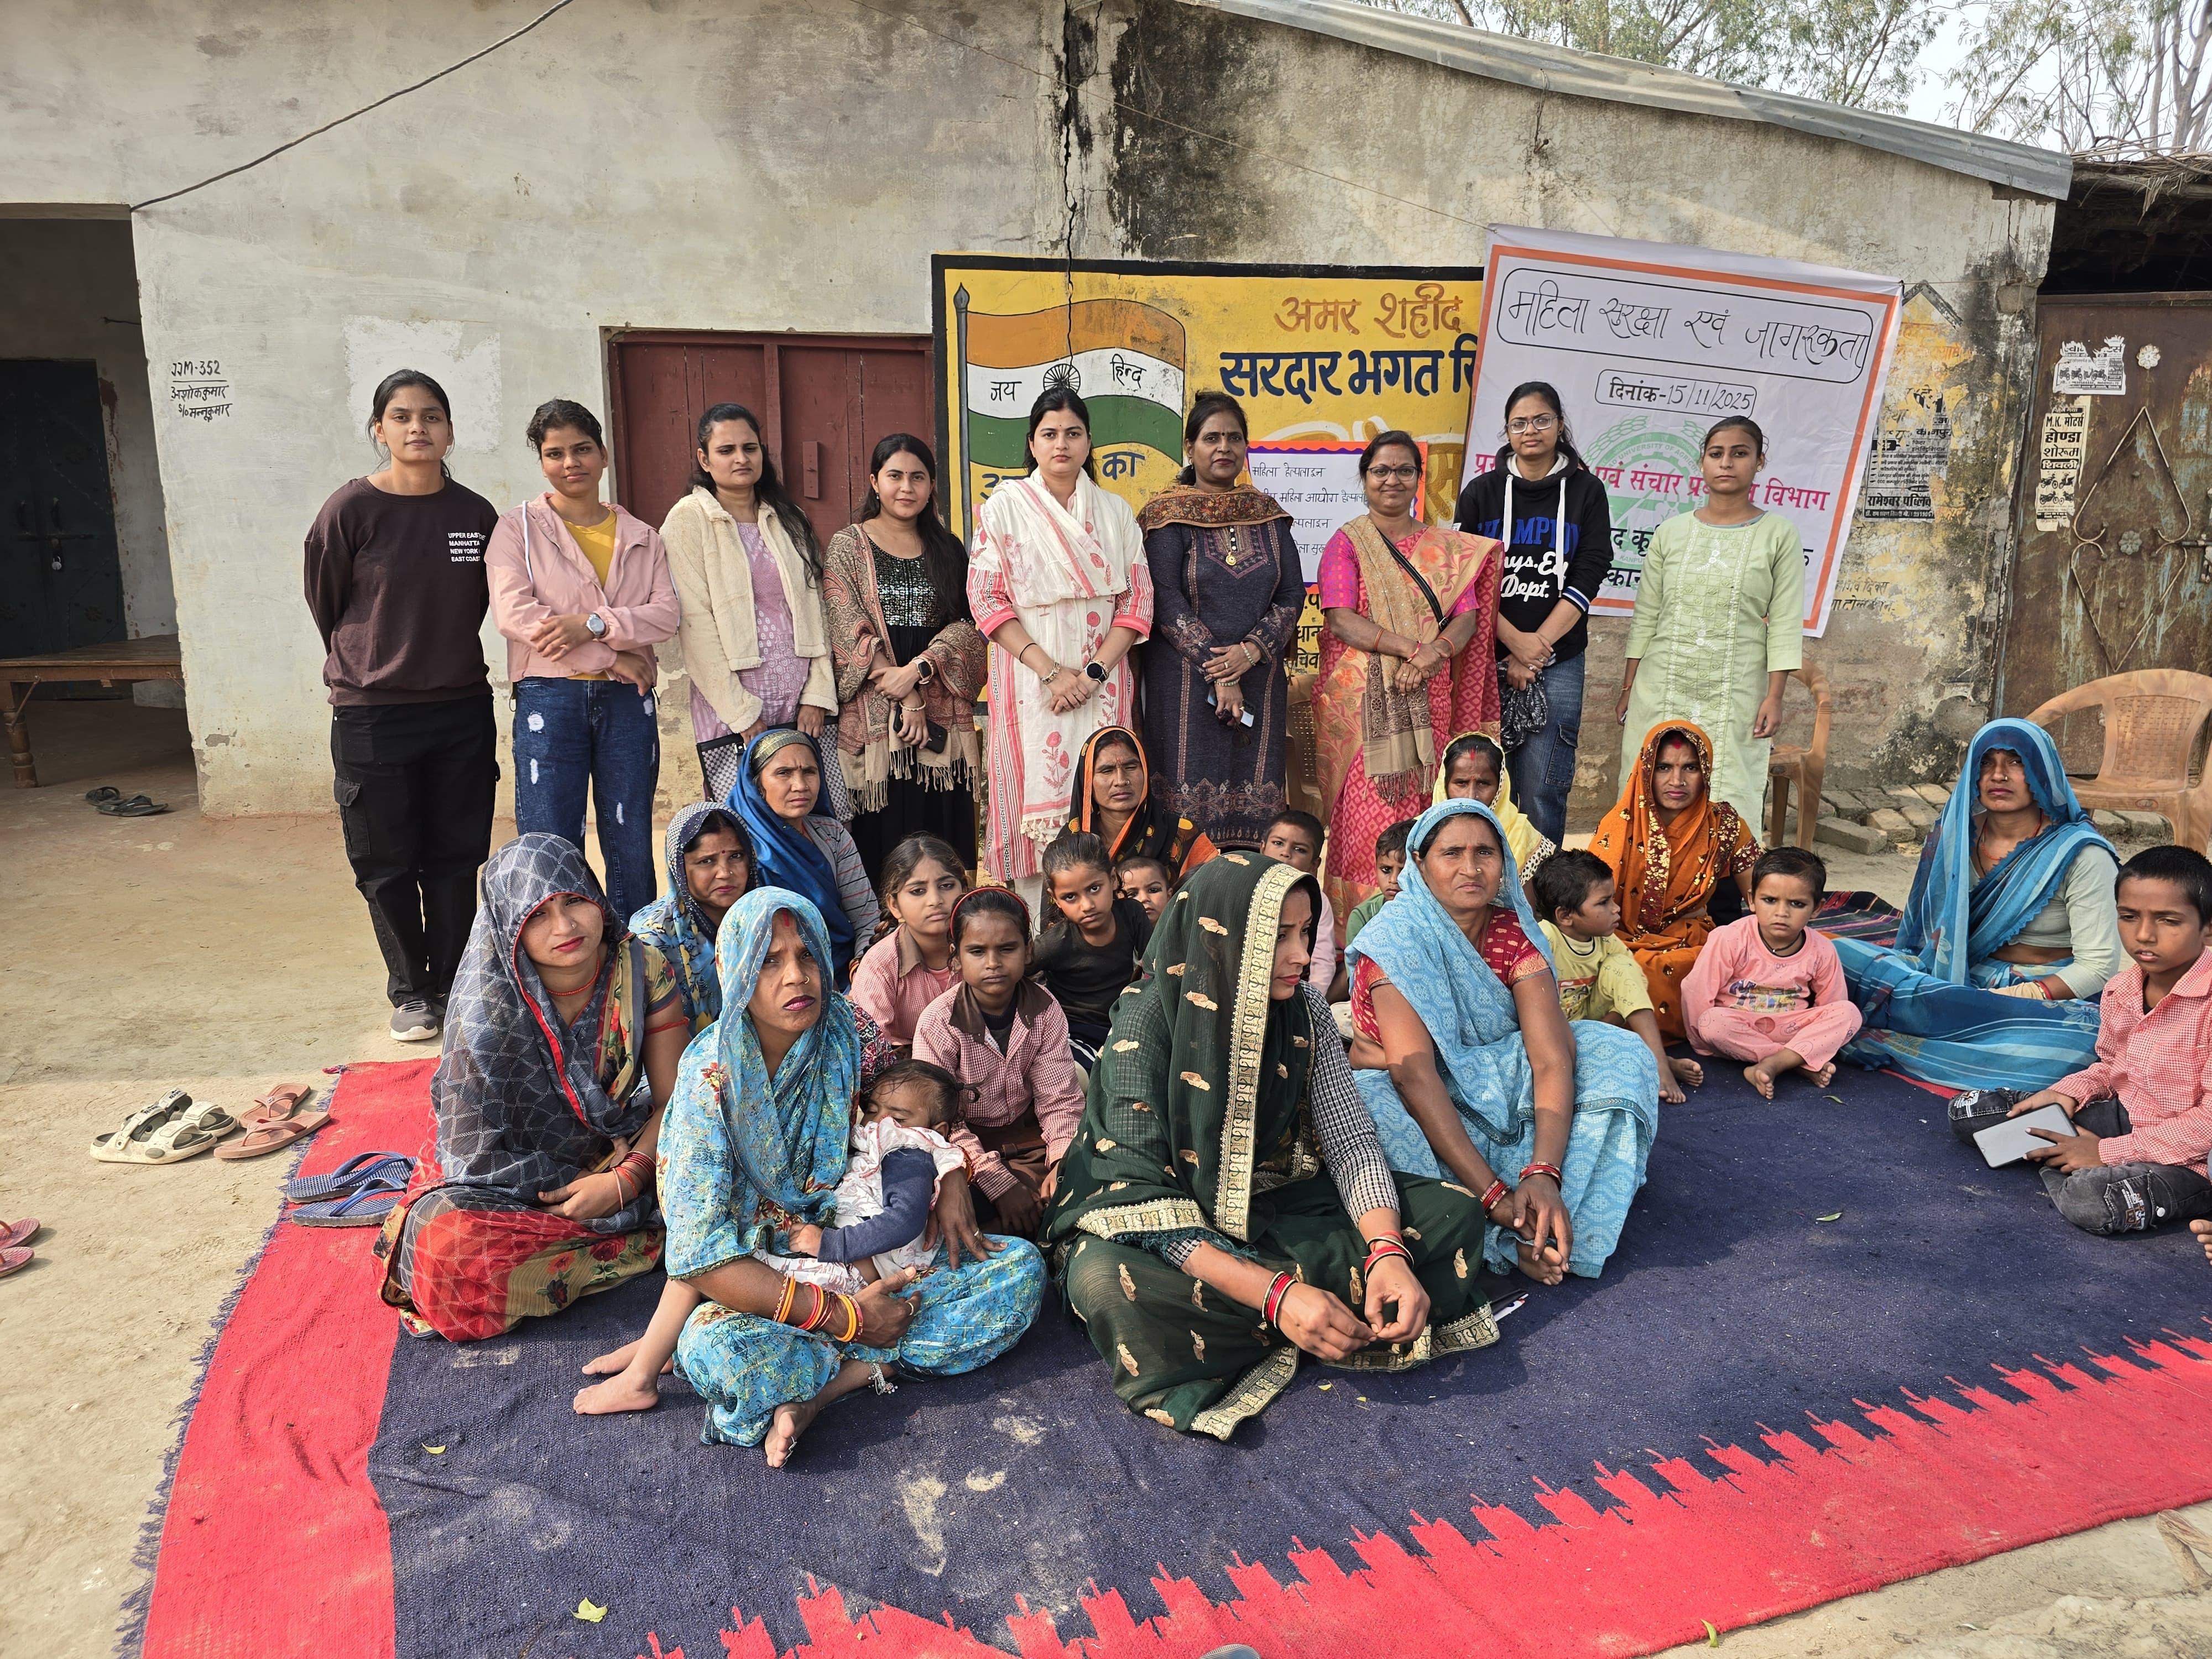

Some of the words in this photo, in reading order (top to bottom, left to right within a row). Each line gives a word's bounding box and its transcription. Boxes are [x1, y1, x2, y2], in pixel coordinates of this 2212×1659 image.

[1274, 296, 1362, 335] अमर
[1374, 283, 1463, 338] शहीद
[1509, 280, 1590, 336] महिला
[1599, 298, 1672, 338] सुरक्षा
[1110, 353, 1147, 389] हिन्द
[1219, 351, 1343, 404] सरदार
[1348, 349, 1444, 396] भगत
[990, 381, 1022, 401] जय
[2046, 416, 2062, 427] M.K.
[2064, 413, 2084, 427] मोटर्स
[2045, 428, 2082, 443] होण्डा
[1618, 443, 1663, 460] UNIVERSITY
[2043, 444, 2079, 457] शोरूम
[1102, 451, 1146, 481] का
[1252, 462, 1281, 477] महिला
[2042, 460, 2078, 469] शिवली
[1279, 488, 1303, 503] महिला
[1305, 487, 1339, 503] आयोग
[1630, 463, 1684, 494] संचार
[1763, 477, 1830, 511] विभाग
[1867, 493, 1901, 507] रामेश्वर
[1500, 573, 1550, 602] Dept.
